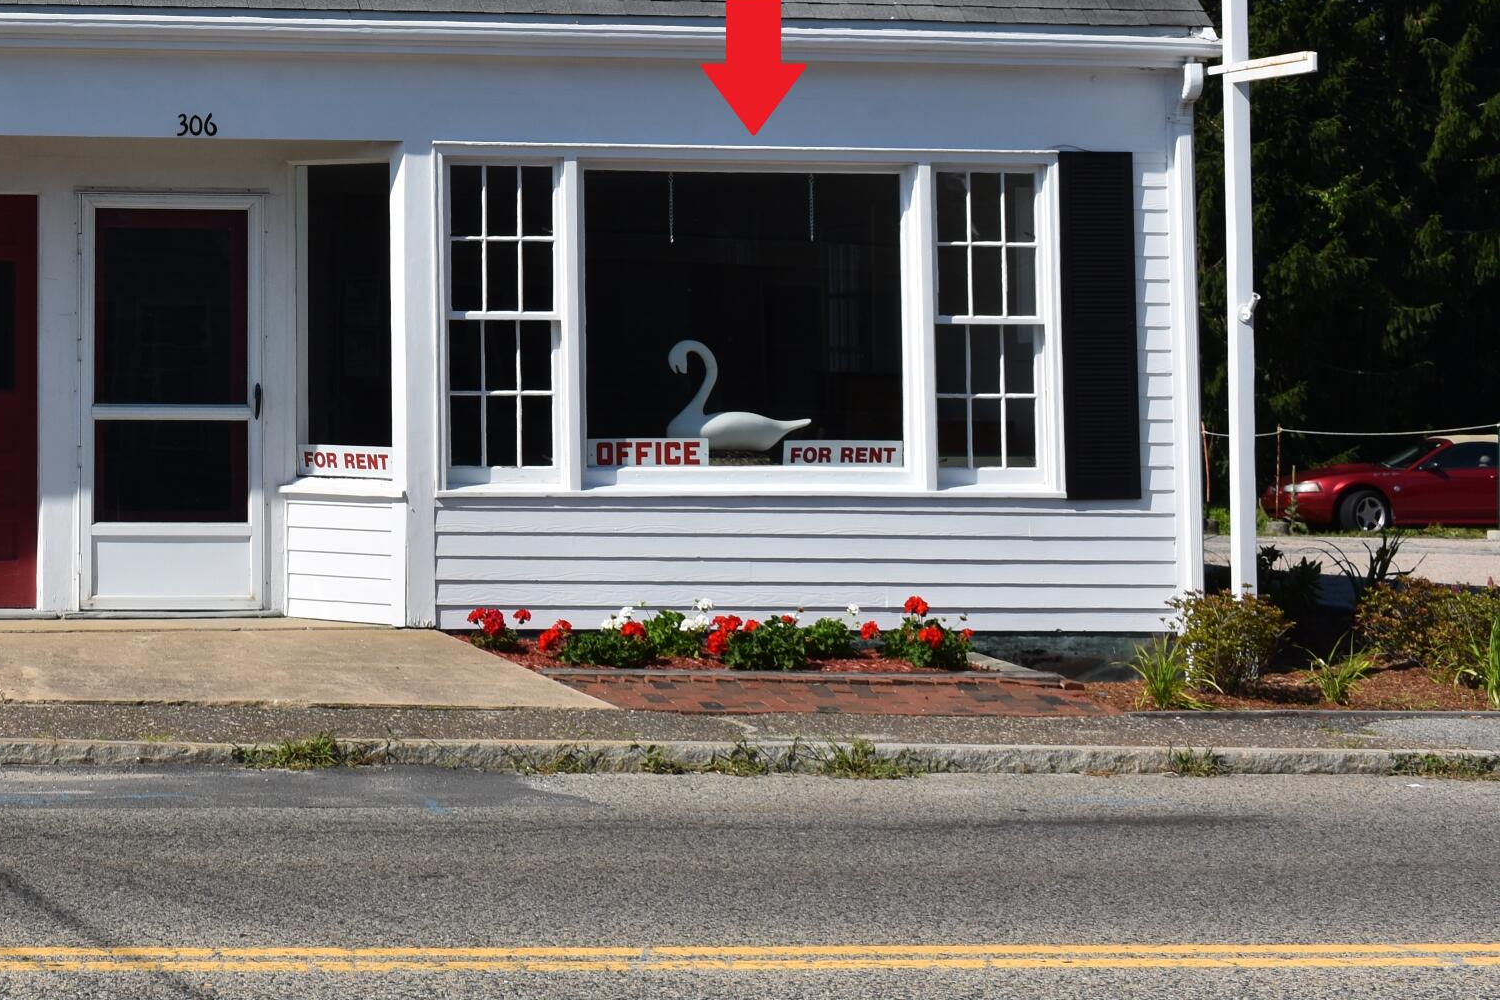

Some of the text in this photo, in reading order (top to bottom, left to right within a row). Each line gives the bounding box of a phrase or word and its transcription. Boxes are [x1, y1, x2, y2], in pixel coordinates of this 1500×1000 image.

[177, 112, 218, 136] 306
[304, 451, 389, 471] FOR RENT
[596, 441, 701, 466] OFFICE
[790, 446, 897, 464] FOR RENT
